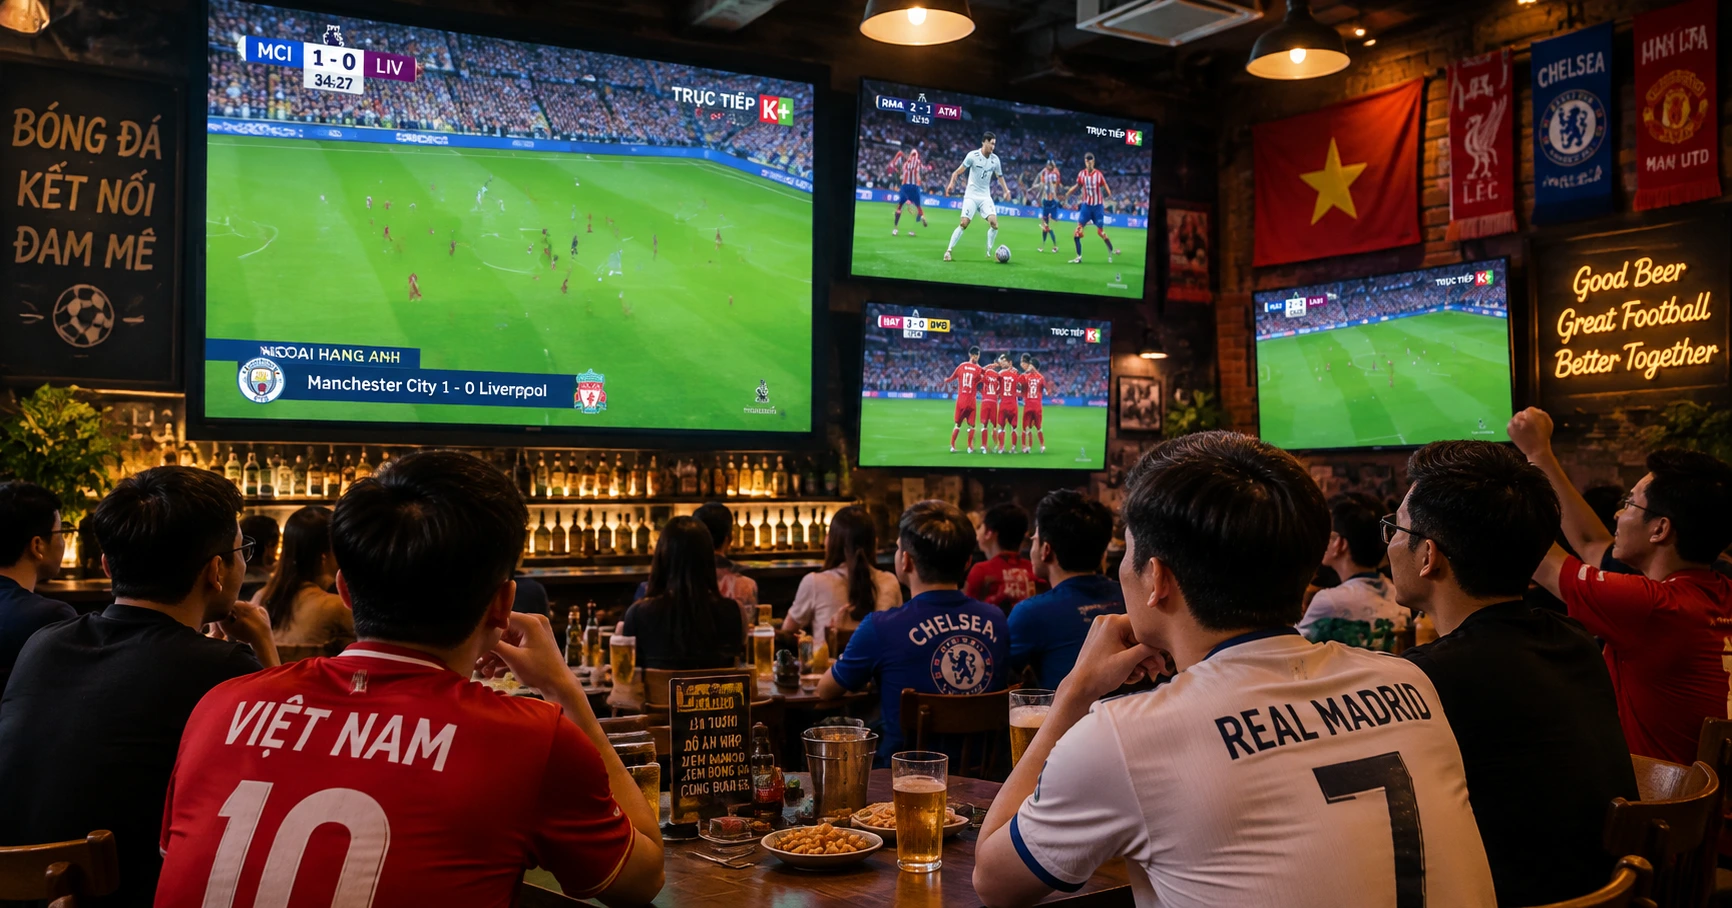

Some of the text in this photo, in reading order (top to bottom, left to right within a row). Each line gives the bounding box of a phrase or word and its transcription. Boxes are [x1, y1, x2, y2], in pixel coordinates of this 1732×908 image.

[258, 42, 292, 62] MCI
[313, 49, 324, 67] 1
[342, 53, 356, 70] 0
[376, 58, 404, 76] LIV
[1537, 52, 1606, 88] CHELSEA
[12, 101, 162, 160] BÓNG ĐÁ
[763, 98, 790, 120] K+
[910, 103, 917, 113] 2
[926, 105, 931, 114] 1
[937, 107, 957, 117] ATM
[1127, 131, 1142, 143] K+
[1680, 149, 1710, 168] UTD
[17, 161, 156, 217] KẾT NỐI
[13, 225, 157, 271] ĐAM MÊ
[1573, 256, 1687, 303] Good Beer
[906, 319, 912, 329] 3
[919, 320, 925, 328] 0
[1557, 291, 1712, 345] Great Football
[319, 348, 364, 363] HANG
[368, 350, 401, 364] ANH
[1555, 337, 1719, 380] Better Together
[307, 375, 402, 392] Manchester
[406, 378, 437, 397] City
[442, 381, 450, 394] 1
[465, 381, 475, 395] 0
[224, 694, 458, 772] VIỆT NAM
[1214, 682, 1432, 761] REAL MADRID
[201, 779, 391, 908] 10
[1311, 750, 1427, 908] 7
